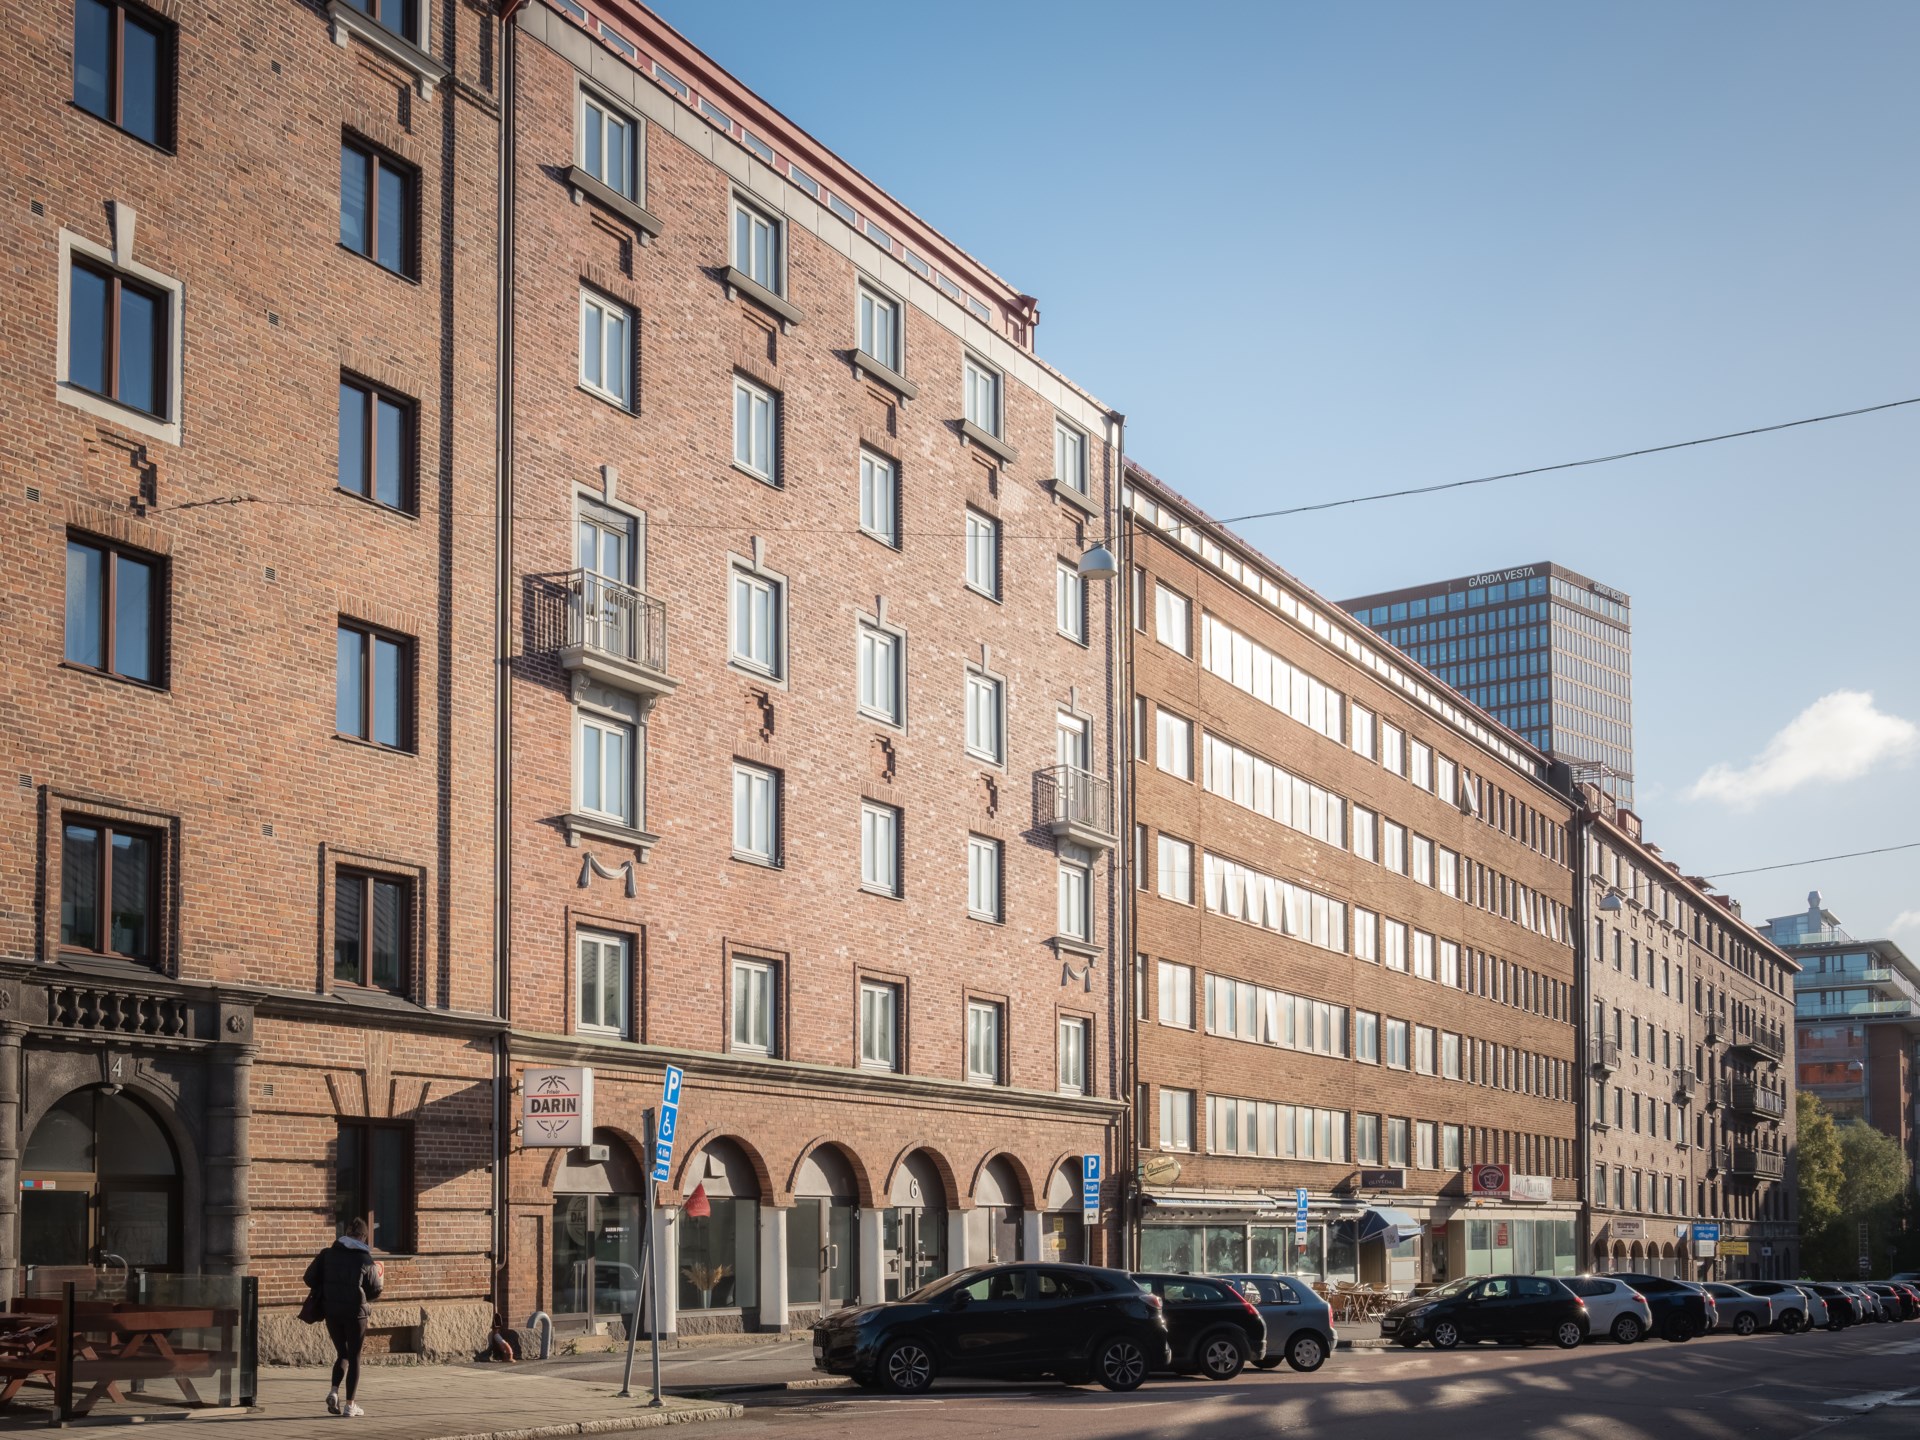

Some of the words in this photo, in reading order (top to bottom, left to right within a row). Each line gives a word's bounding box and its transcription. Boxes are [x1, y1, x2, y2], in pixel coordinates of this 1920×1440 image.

[1468, 573, 1502, 588] GÅRDA
[1504, 567, 1535, 581] VESTA
[112, 1057, 122, 1077] 4
[667, 1071, 679, 1100] P
[531, 1098, 576, 1113] DARIN
[1088, 1157, 1097, 1177] P
[910, 1178, 919, 1199] 6
[1085, 1184, 1098, 1192] Avgift
[1300, 1190, 1305, 1207] P
